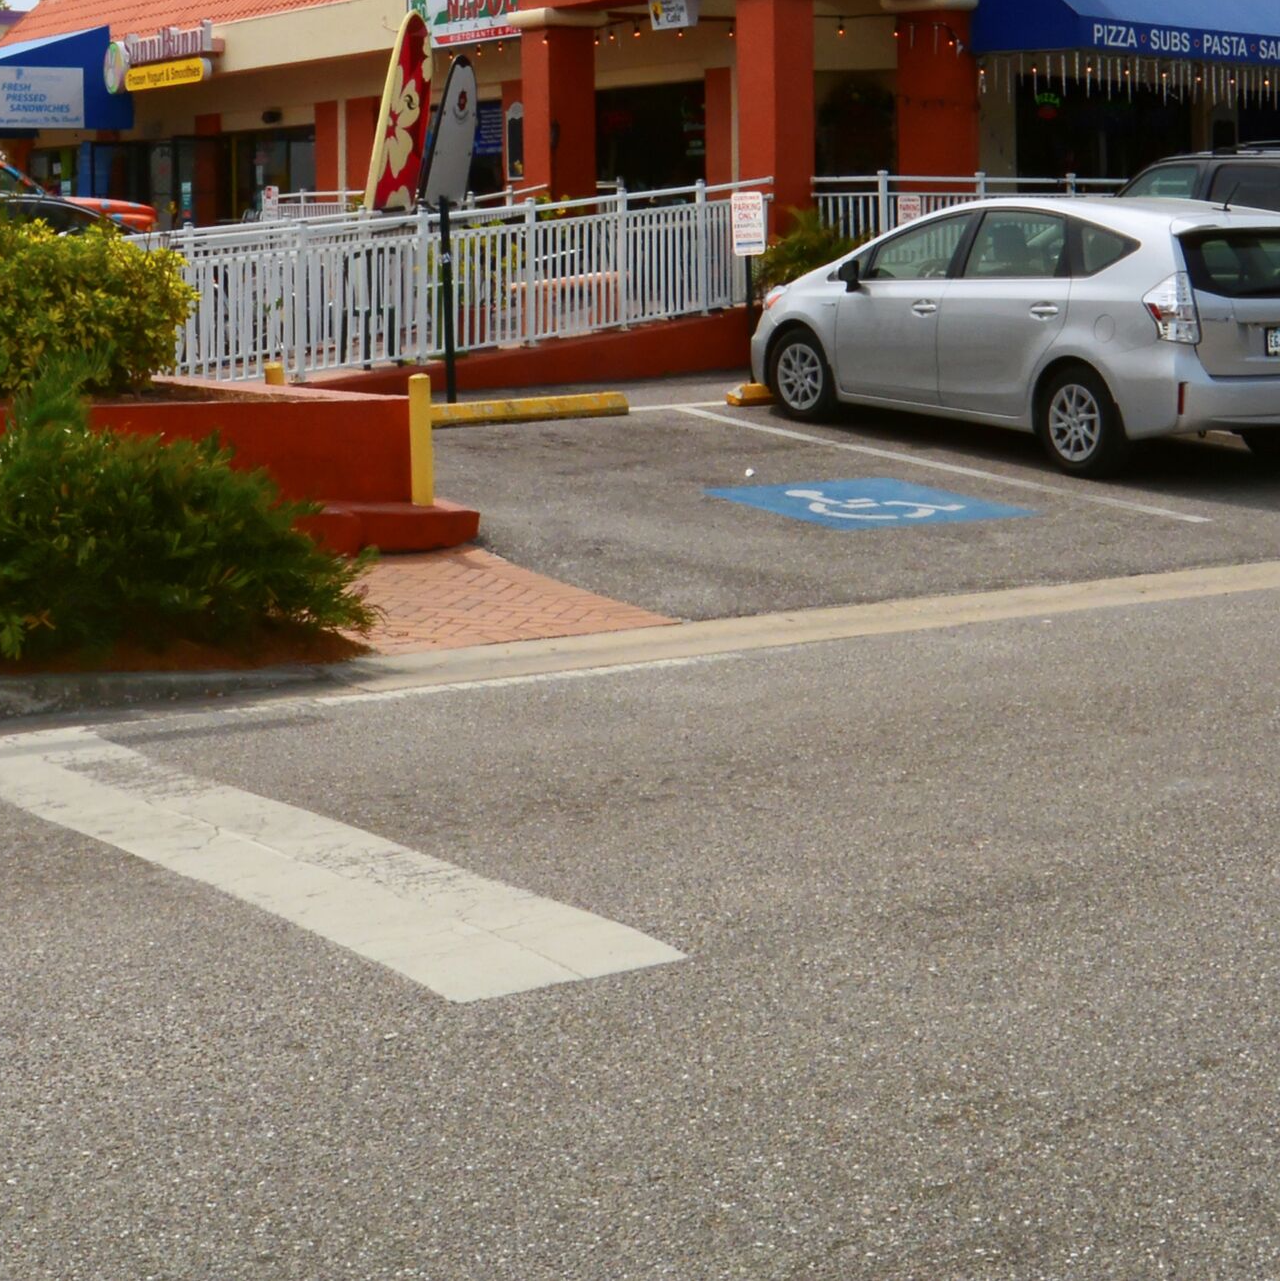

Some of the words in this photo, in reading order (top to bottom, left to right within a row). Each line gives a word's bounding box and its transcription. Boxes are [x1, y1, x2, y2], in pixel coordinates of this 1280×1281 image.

[1093, 23, 1138, 48] PIZZA
[1150, 29, 1190, 52] SUBS
[1203, 34, 1248, 57] PASTA
[1, 82, 32, 92] FRESH
[6, 92, 48, 102] PRESSED
[9, 103, 71, 113] SANDWICHES
